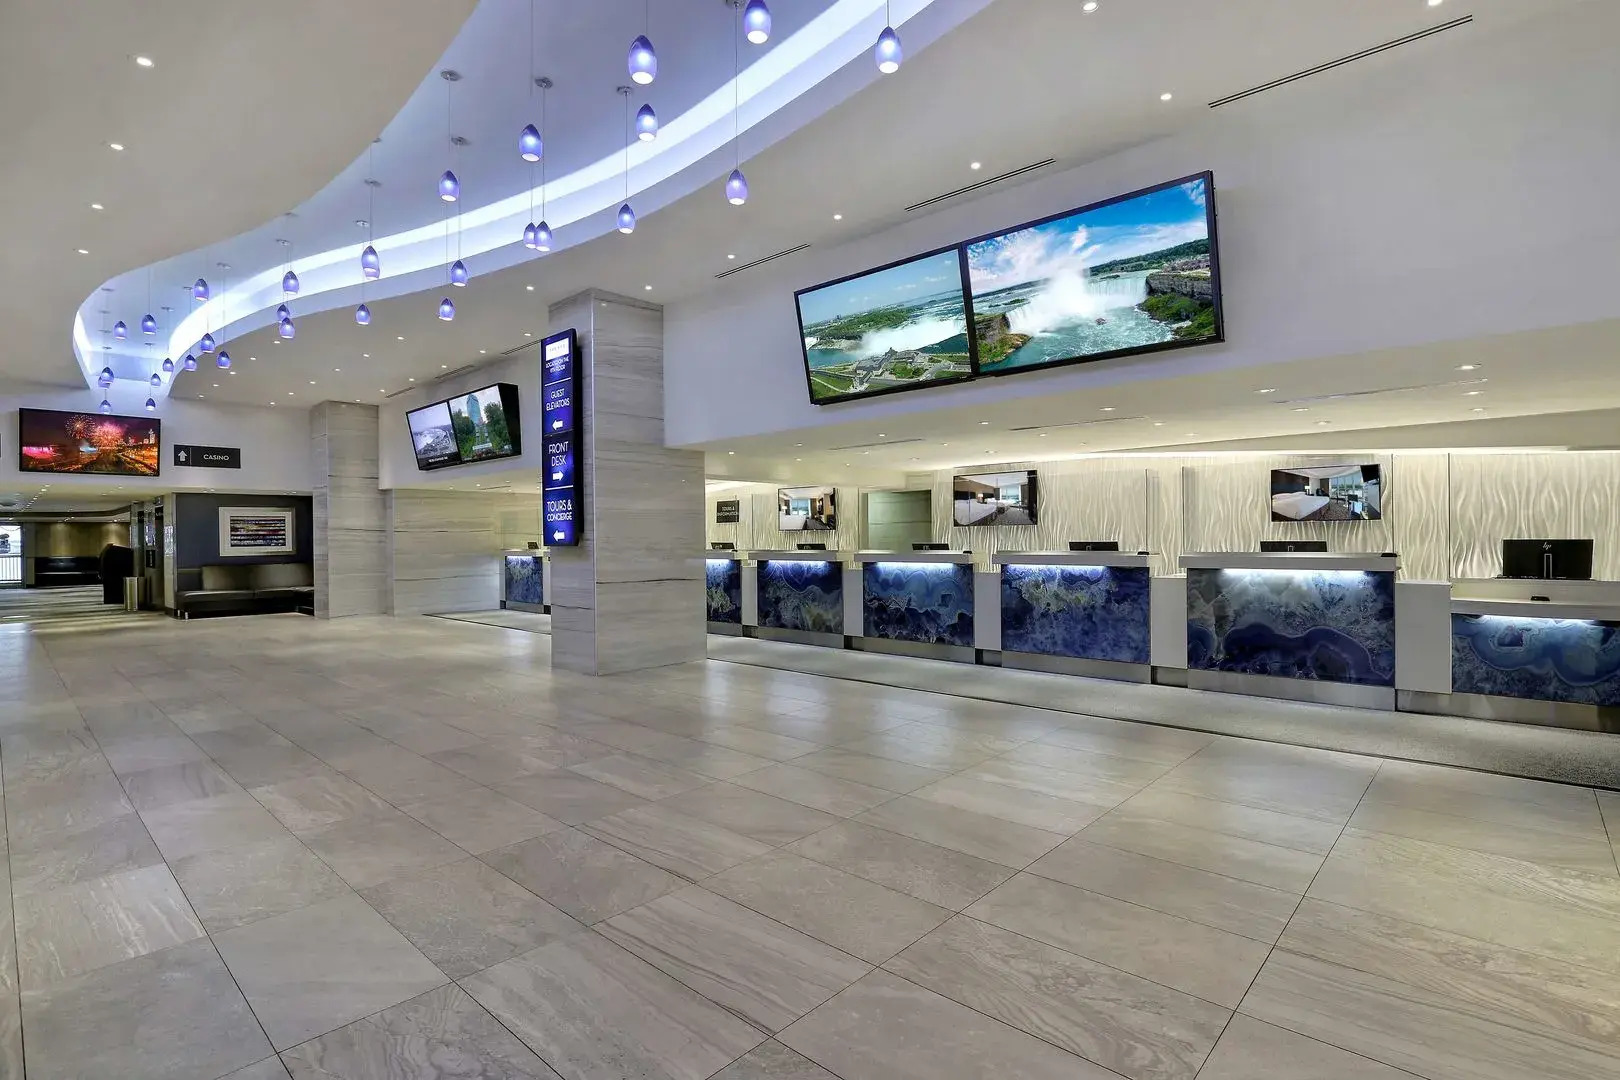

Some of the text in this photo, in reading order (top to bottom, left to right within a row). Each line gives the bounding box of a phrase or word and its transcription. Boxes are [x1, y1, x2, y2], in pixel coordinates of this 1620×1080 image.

[551, 388, 564, 399] GUEST
[546, 397, 570, 411] ELEVATORS
[548, 441, 568, 454] FRONT
[551, 454, 566, 467] DESK
[547, 499, 572, 512] TOURS &
[547, 512, 572, 522] CONCIERGE
